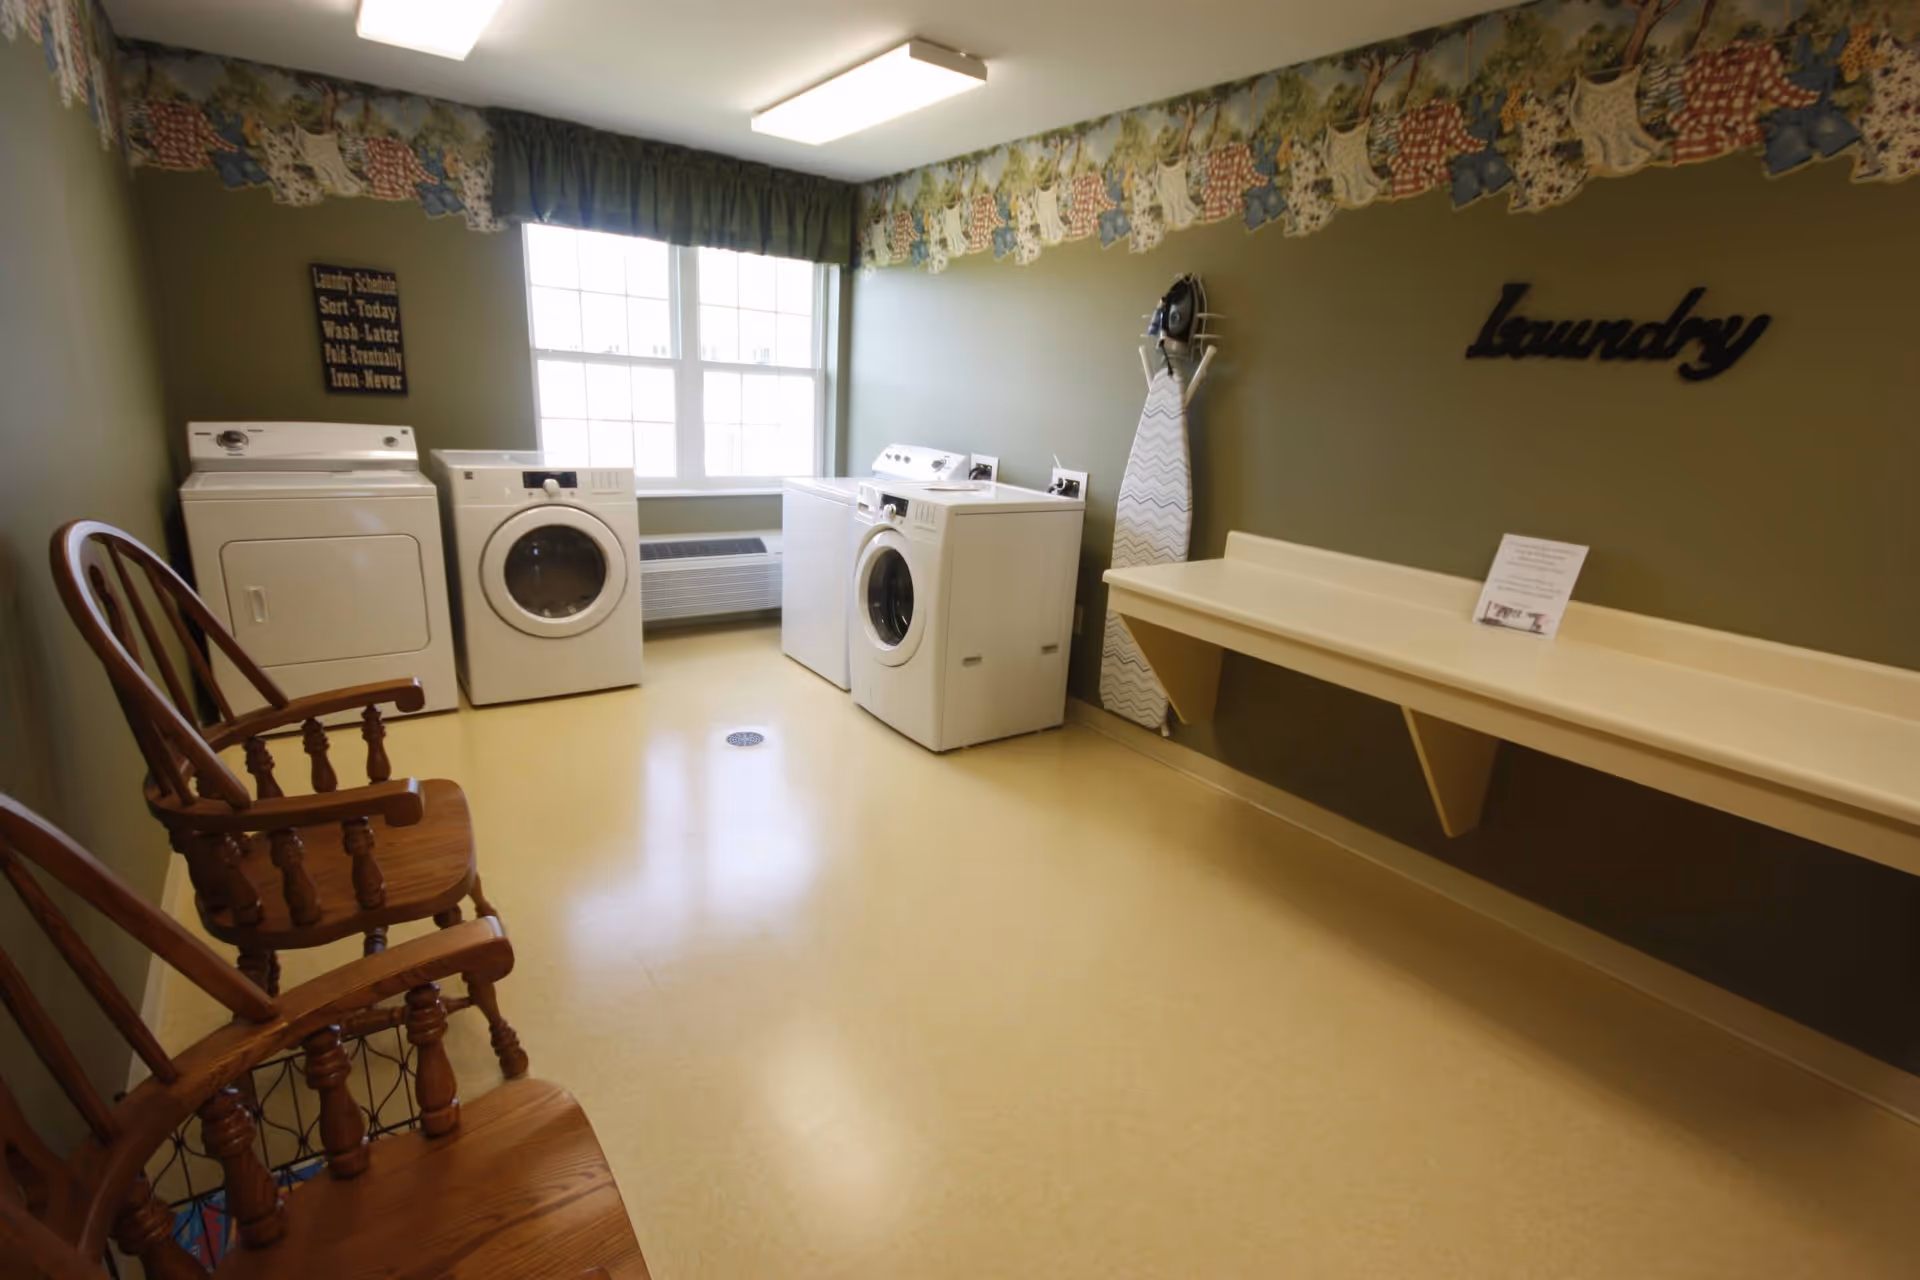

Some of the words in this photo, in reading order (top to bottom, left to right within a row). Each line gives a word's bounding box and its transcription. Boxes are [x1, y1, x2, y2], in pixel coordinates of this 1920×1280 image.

[320, 296, 349, 315] Sort
[355, 299, 397, 322] Today
[322, 320, 359, 340] Wash
[364, 323, 399, 343] Later
[331, 368, 359, 388] Iron
[364, 369, 401, 389] Never
